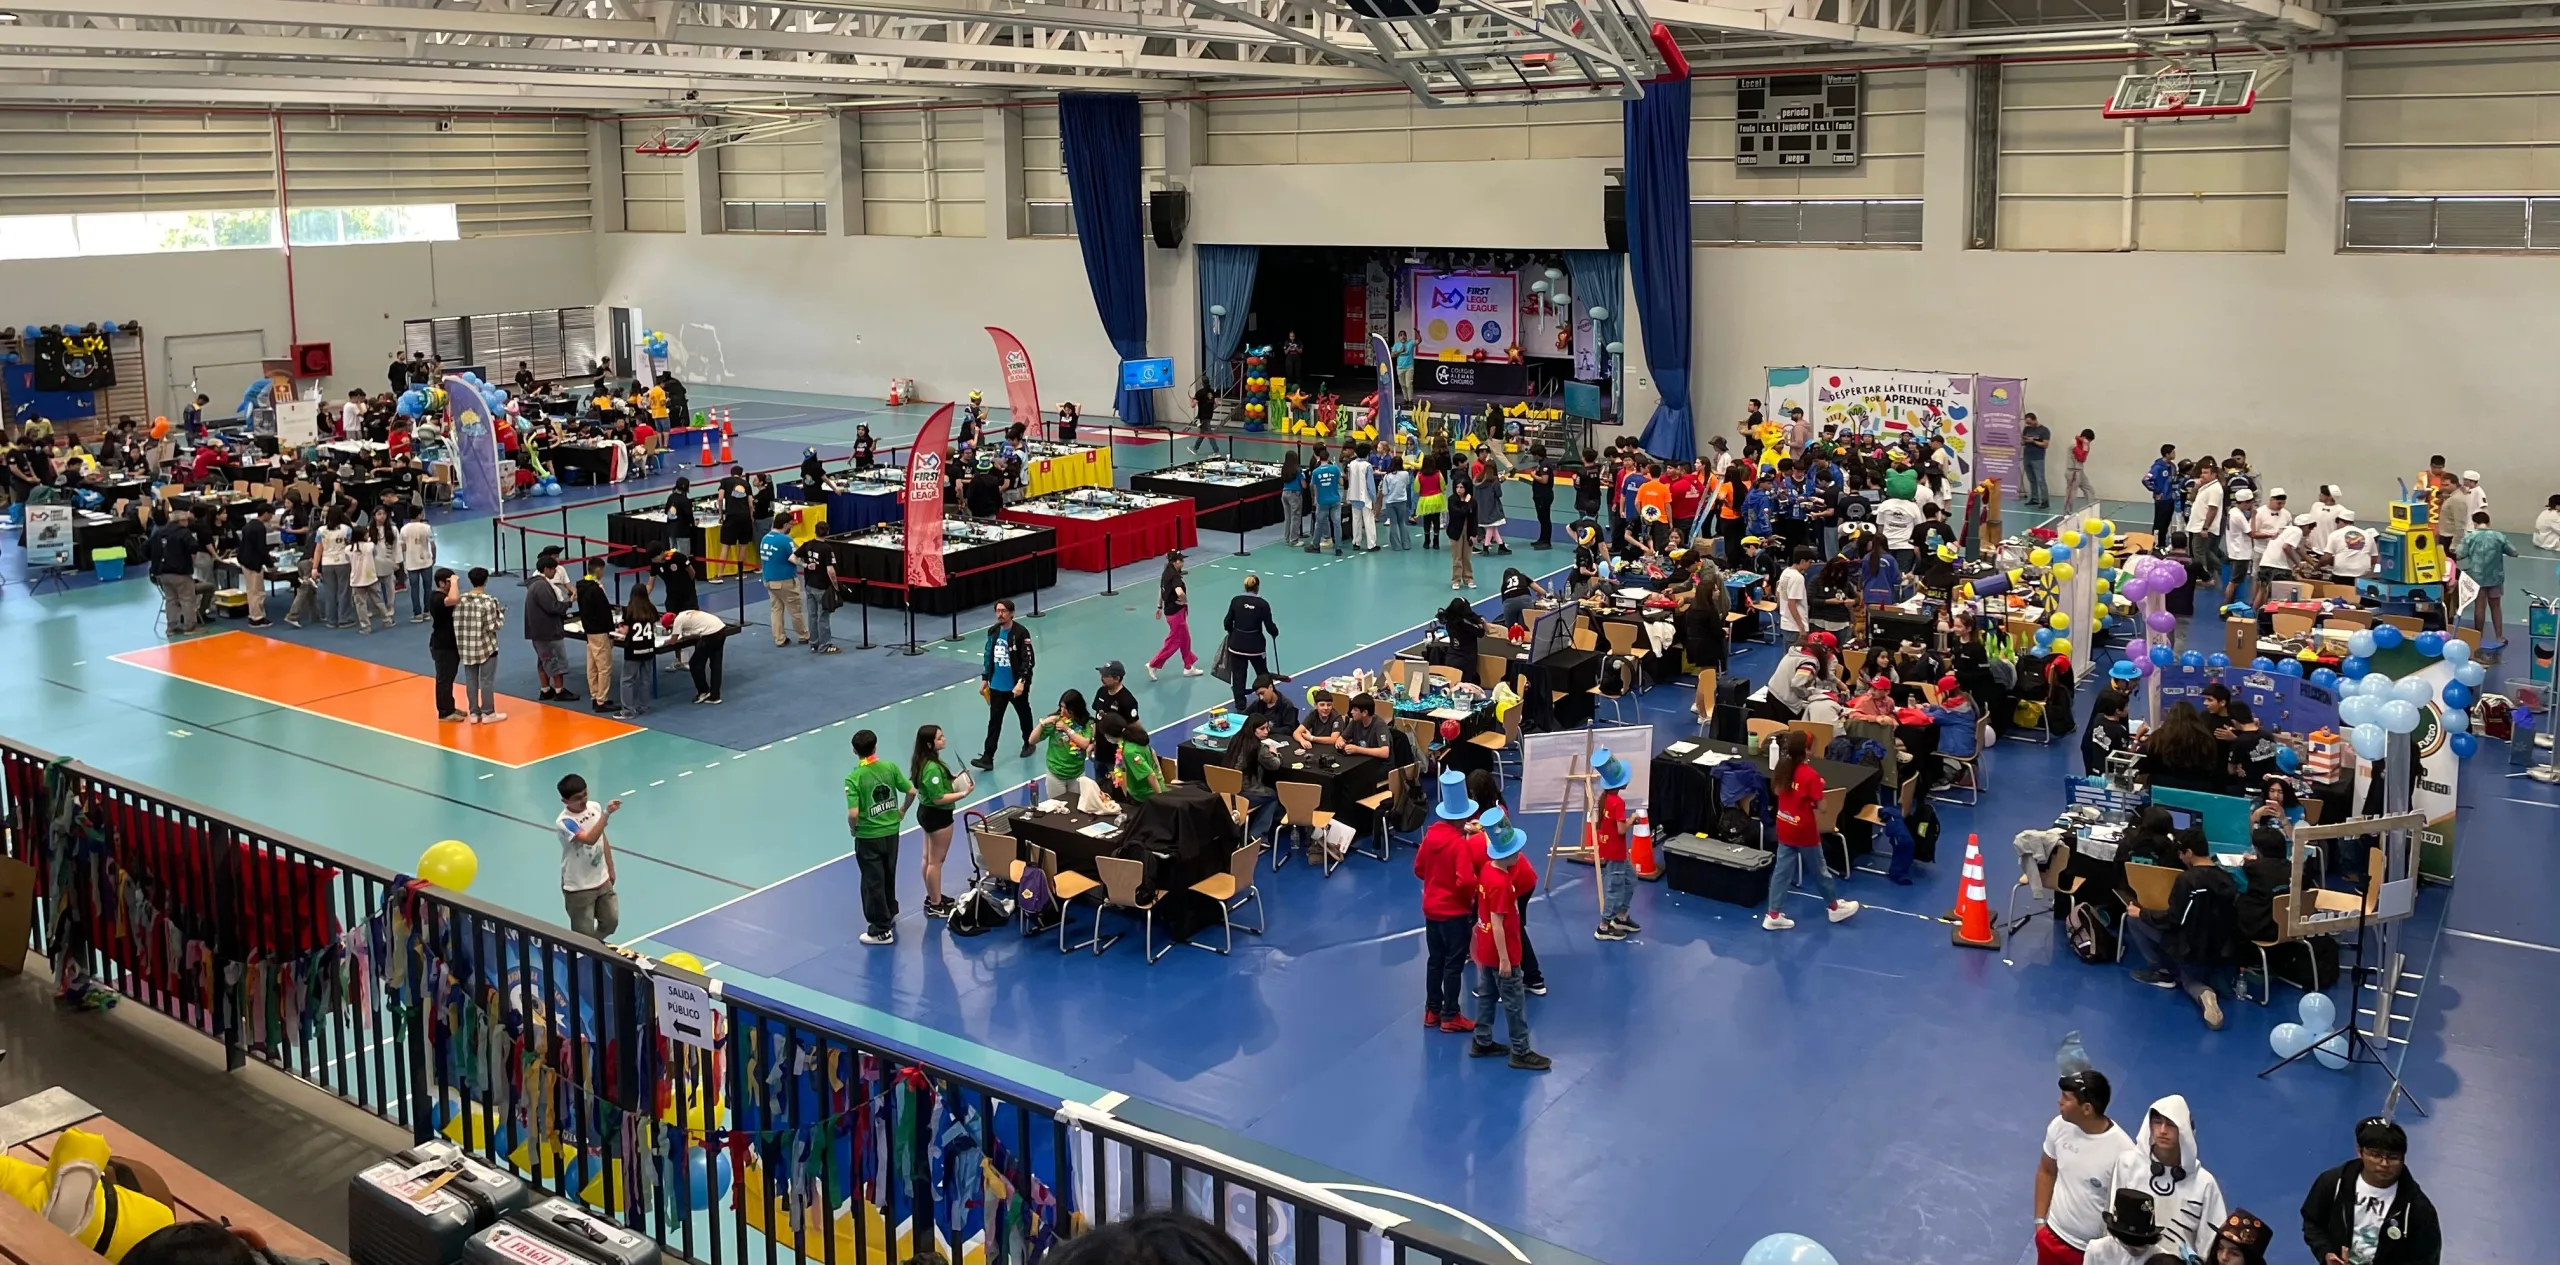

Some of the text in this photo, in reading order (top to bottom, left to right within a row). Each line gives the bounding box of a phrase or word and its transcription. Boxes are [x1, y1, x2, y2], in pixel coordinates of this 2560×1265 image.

[1741, 78, 1762, 88] Local
[1782, 108, 1809, 117] periodo
[1782, 122, 1809, 131] jugador
[1835, 121, 1853, 130] fouls
[1737, 155, 1757, 164] tantos
[1785, 154, 1805, 164] juego
[1833, 154, 1854, 163] tantos
[1467, 287, 1490, 296] FIRST
[1466, 296, 1487, 304] LEGO
[1466, 304, 1498, 312] LEAGUE
[1450, 367, 1475, 375] COLEGIO
[1829, 384, 1949, 402] DESPERTAR LA FELICIDAD
[1865, 394, 1943, 407] POR APRENDER
[914, 471, 939, 482] FIRST
[632, 622, 653, 642] 24
[2417, 723, 2437, 749] FUEGO
[668, 985, 696, 1003] SALIDA
[667, 1001, 700, 1020] PÚBLICO
